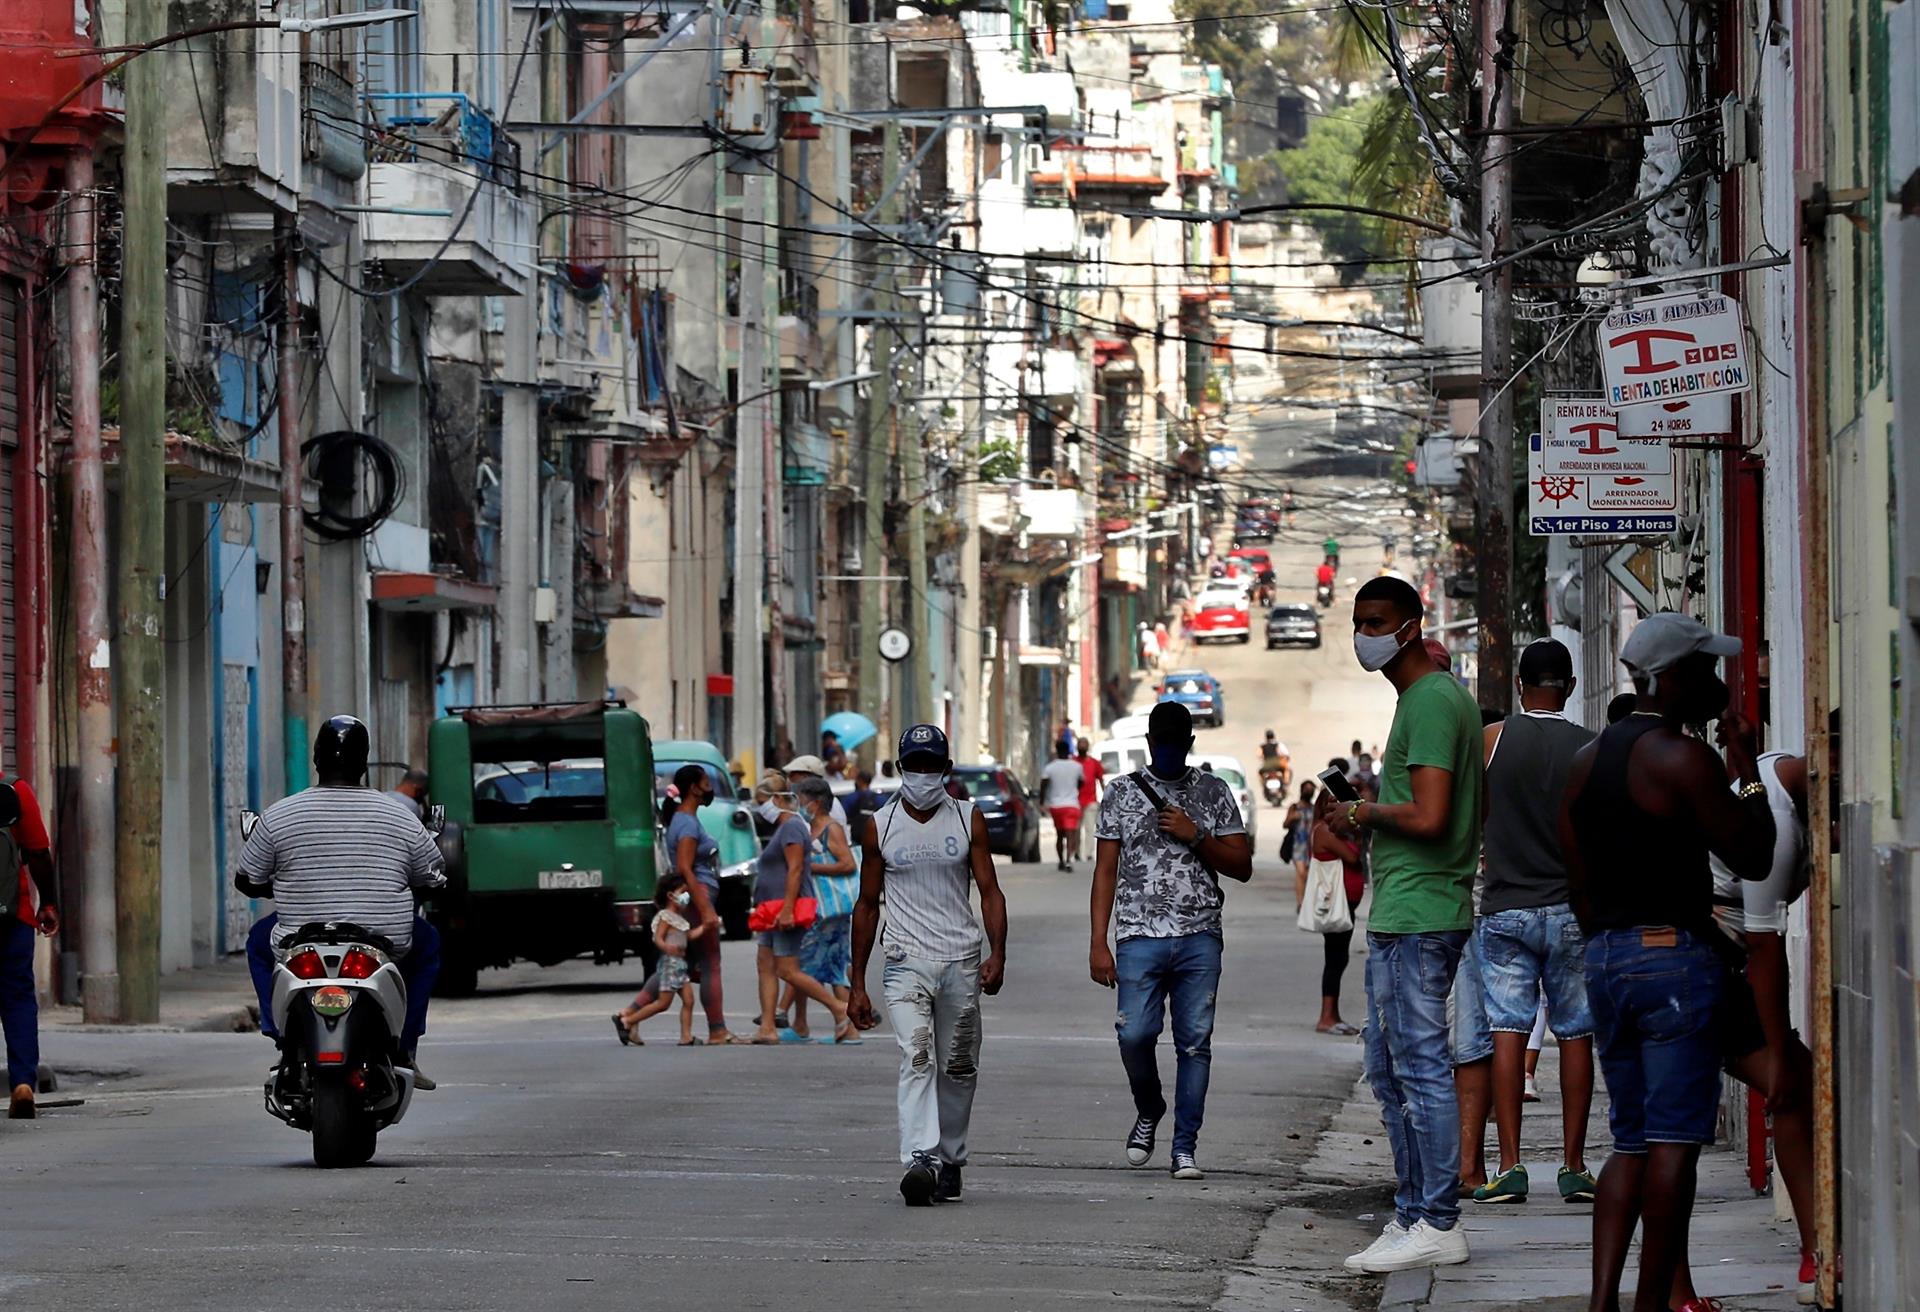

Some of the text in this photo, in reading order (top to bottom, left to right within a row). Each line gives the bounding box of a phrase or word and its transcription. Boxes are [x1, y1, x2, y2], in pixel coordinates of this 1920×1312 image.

[1607, 307, 1657, 330] CASA
[1612, 364, 1743, 403] RENTA DE HABITACIÓN
[1557, 405, 1585, 418] RENTA
[1586, 405, 1598, 418] DE
[1651, 418, 1692, 431] 24 HORAS
[1559, 461, 1592, 471] ARRENDADOR
[1593, 461, 1601, 471] EN
[1601, 461, 1622, 471] MONEDA
[1605, 490, 1659, 498] ARRENDADOR
[1556, 518, 1673, 531] 1er Piso 24 Horas
[945, 836, 959, 857] 8
[909, 851, 943, 859] PATROL
